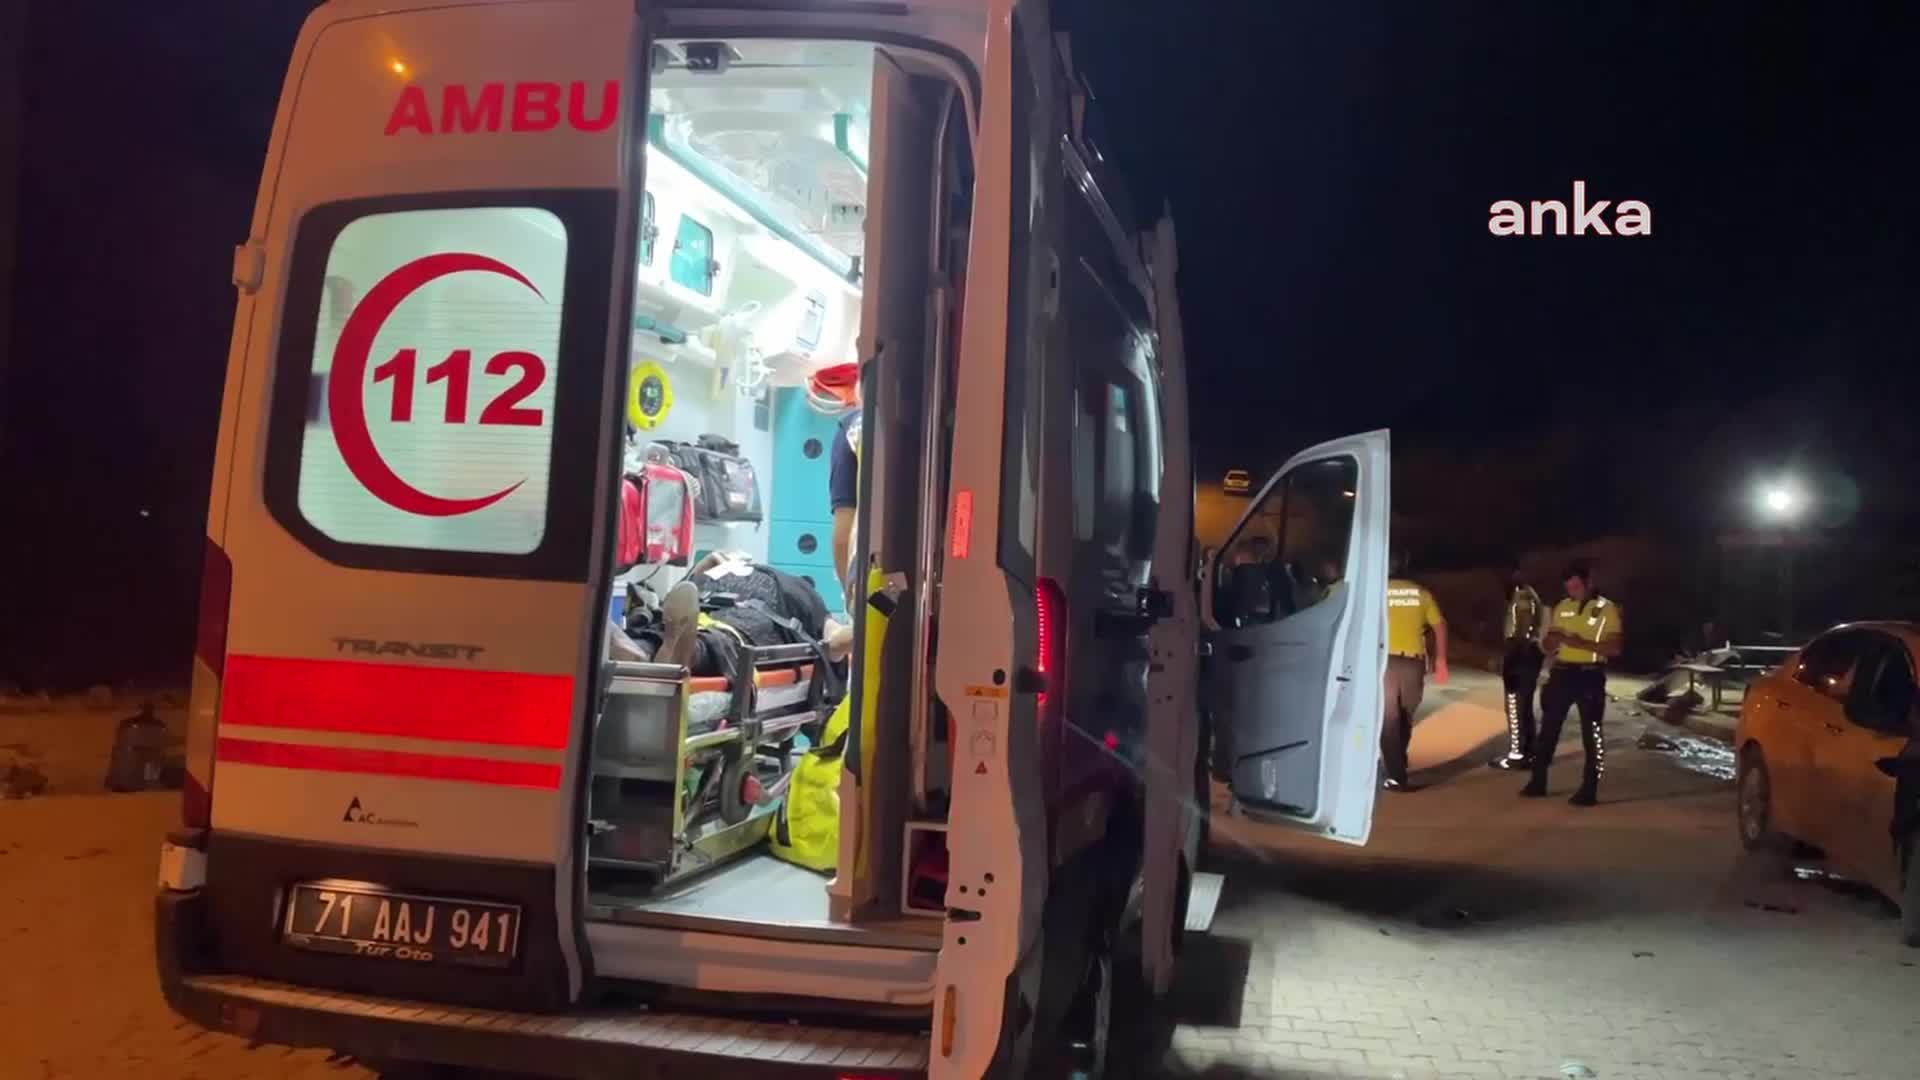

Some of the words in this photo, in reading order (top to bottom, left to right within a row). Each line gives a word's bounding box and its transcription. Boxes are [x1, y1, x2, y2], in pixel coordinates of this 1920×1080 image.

[384, 80, 621, 136] AMBU
[373, 349, 546, 426] 112
[315, 892, 353, 936] 71
[373, 900, 435, 944] AAJ
[450, 909, 510, 952] 941
